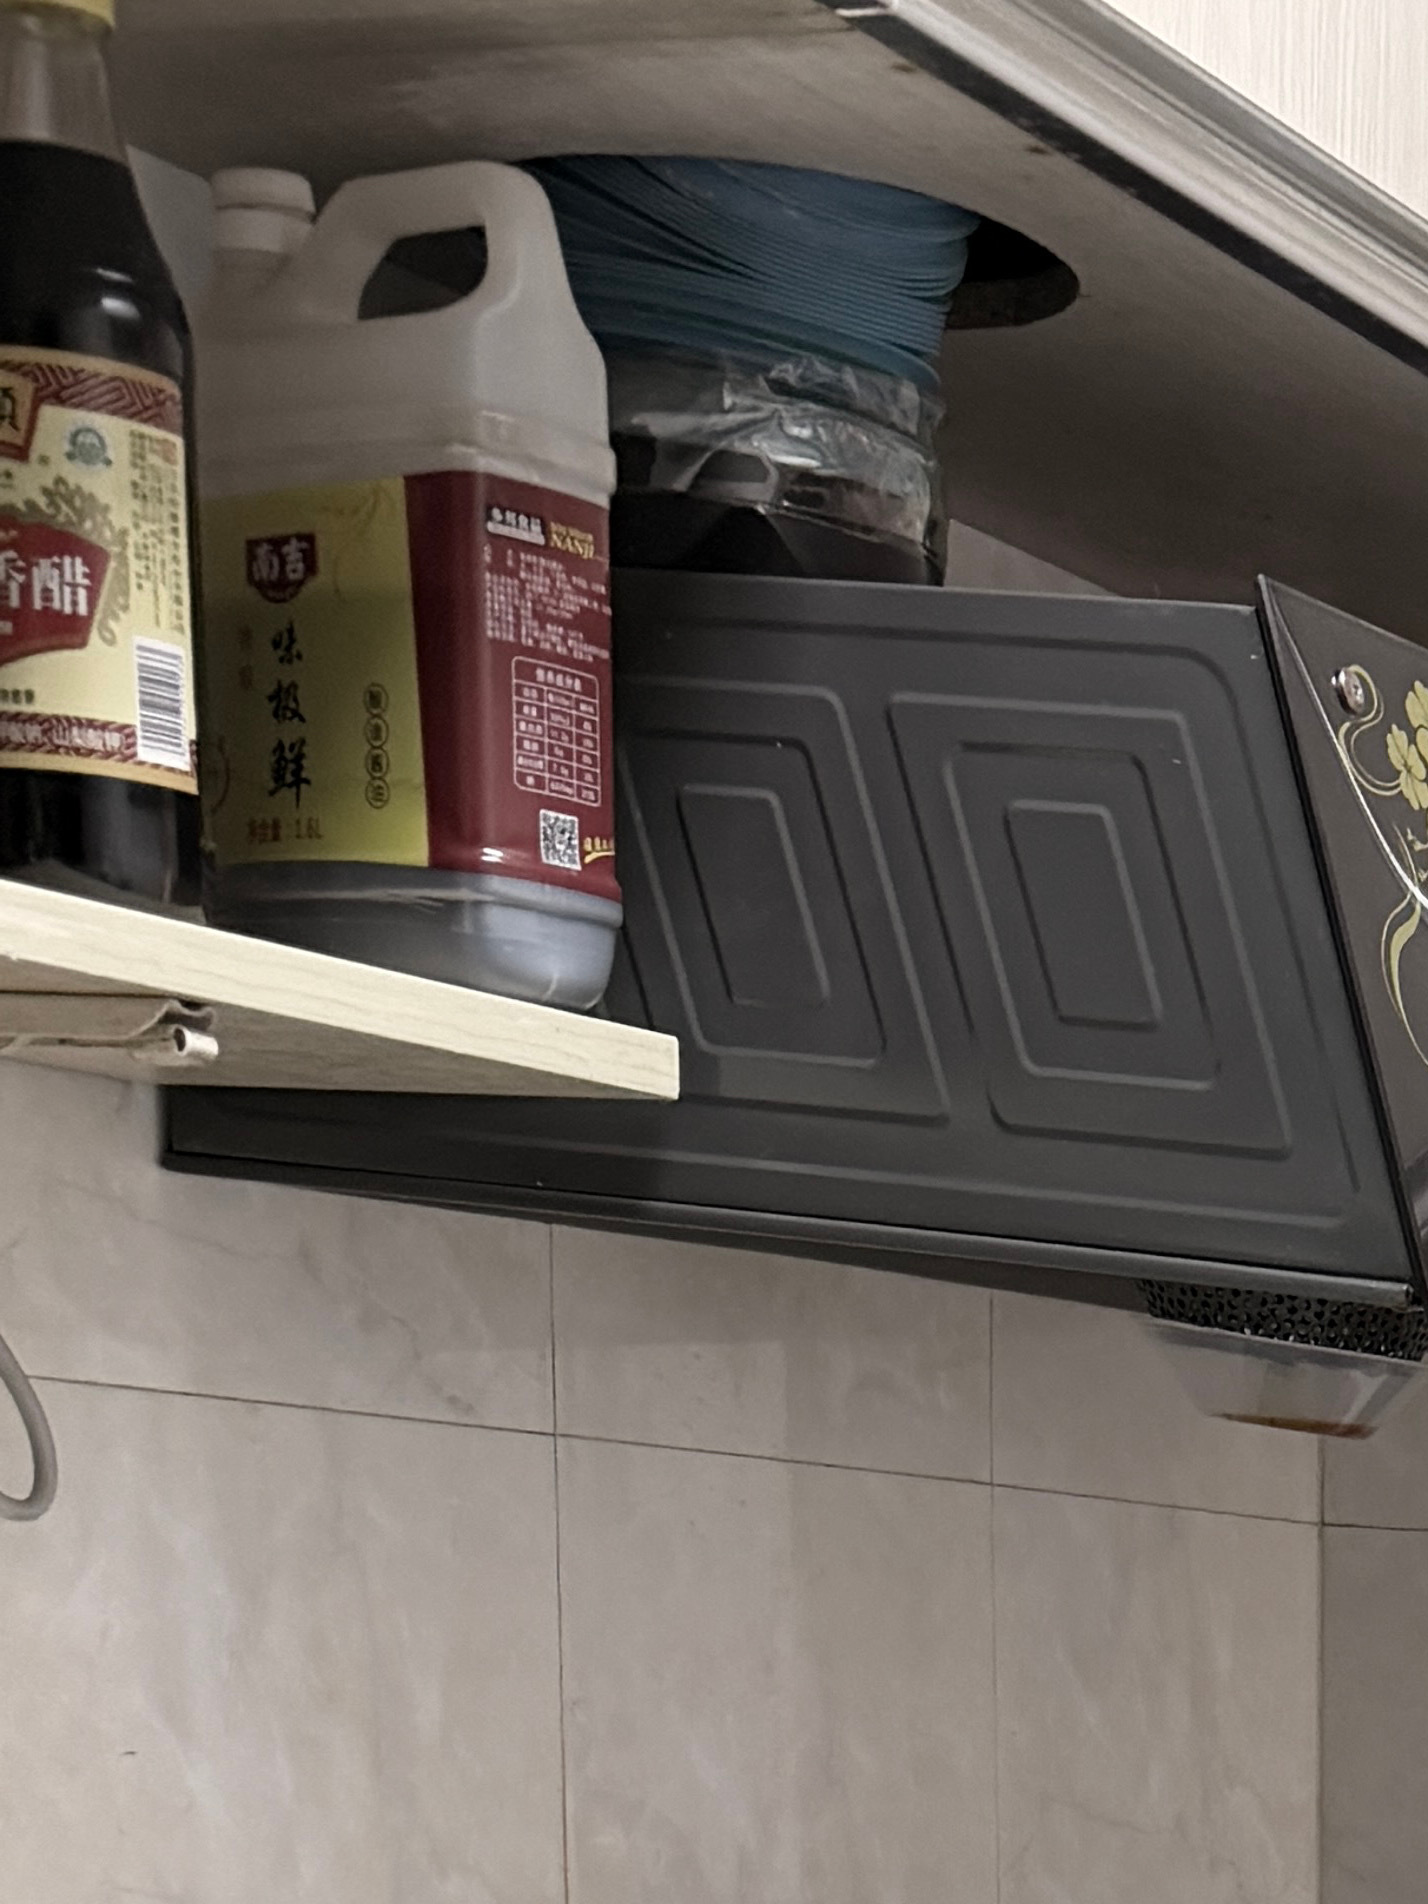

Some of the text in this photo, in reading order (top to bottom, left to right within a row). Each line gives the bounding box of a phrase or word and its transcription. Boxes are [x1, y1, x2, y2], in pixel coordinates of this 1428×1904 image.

[0, 549, 92, 617] 香醋
[252, 537, 310, 582] 南吉
[264, 617, 312, 809] 味极鲜
